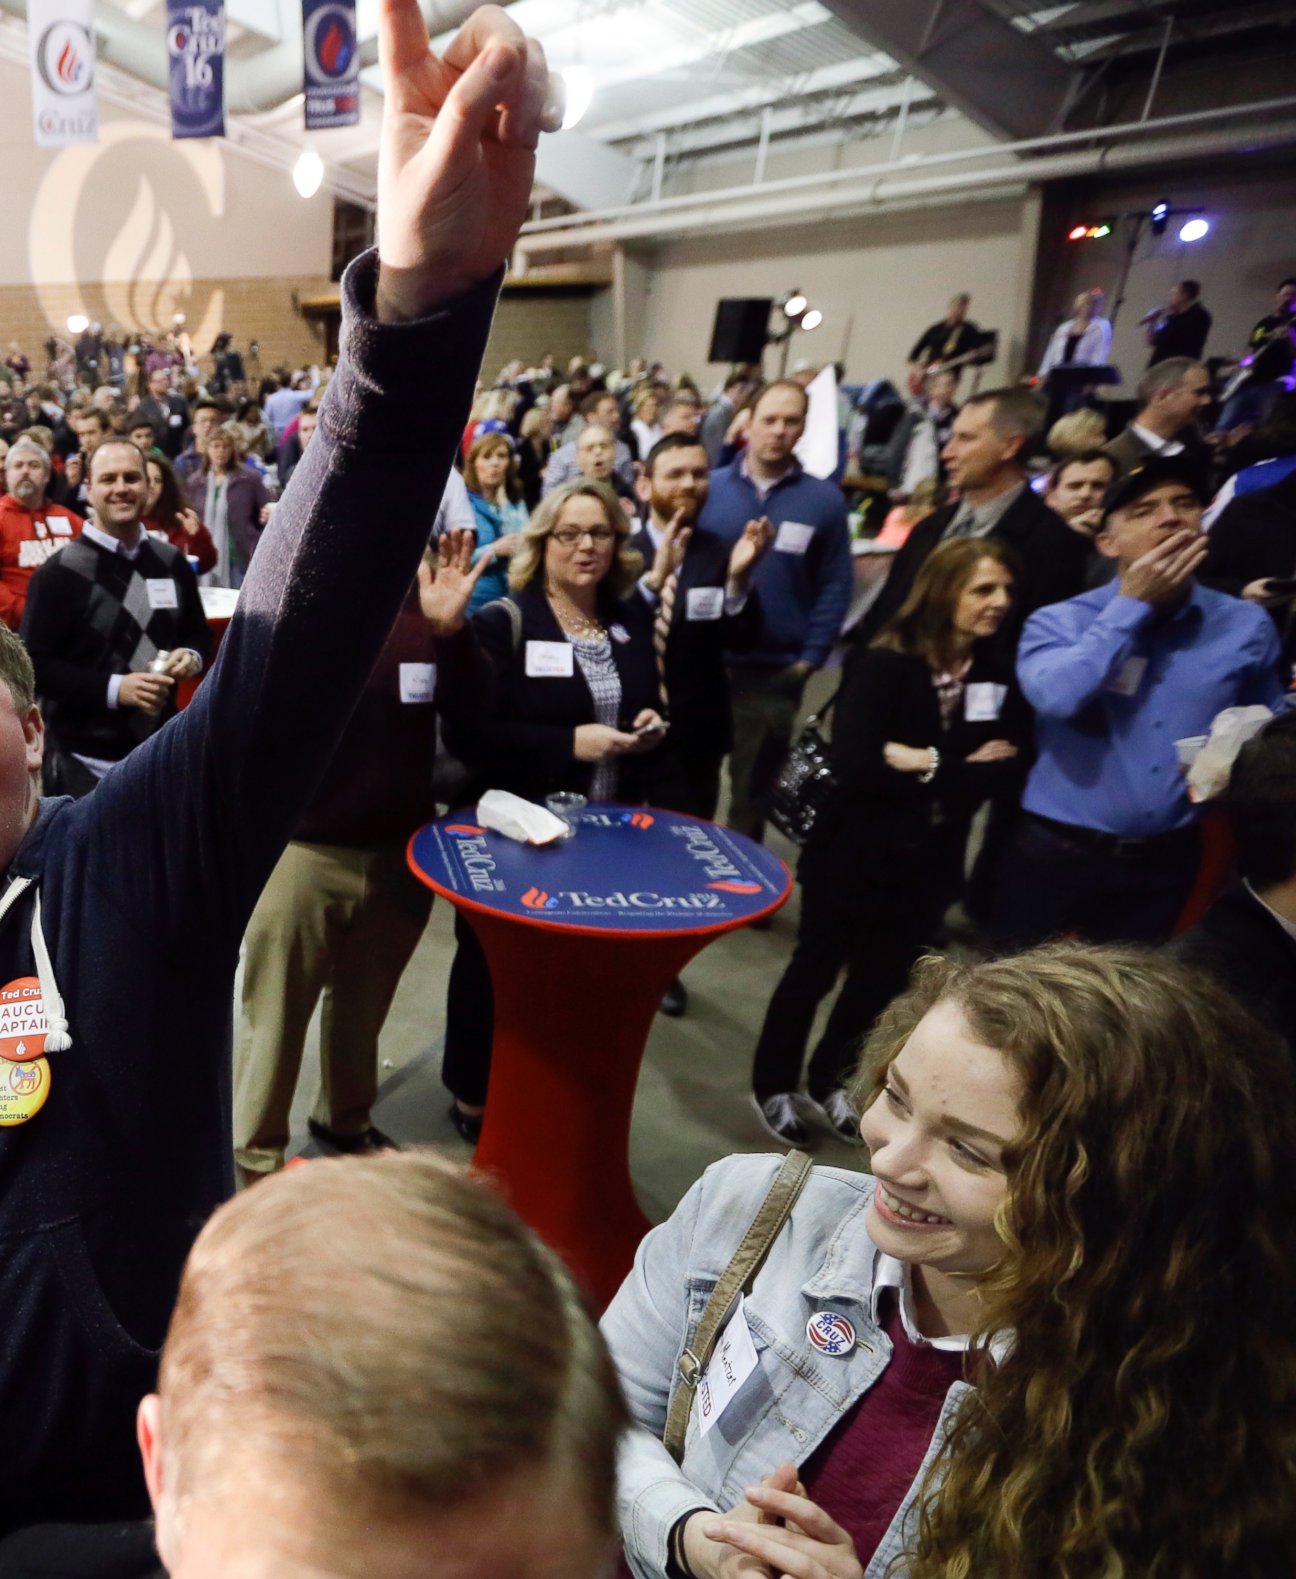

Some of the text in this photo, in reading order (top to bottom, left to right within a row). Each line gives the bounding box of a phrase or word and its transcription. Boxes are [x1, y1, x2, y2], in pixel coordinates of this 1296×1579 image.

[185, 54, 214, 89] 16
[1, 989, 20, 1000] Ted
[816, 1320, 846, 1347] CRUZ
